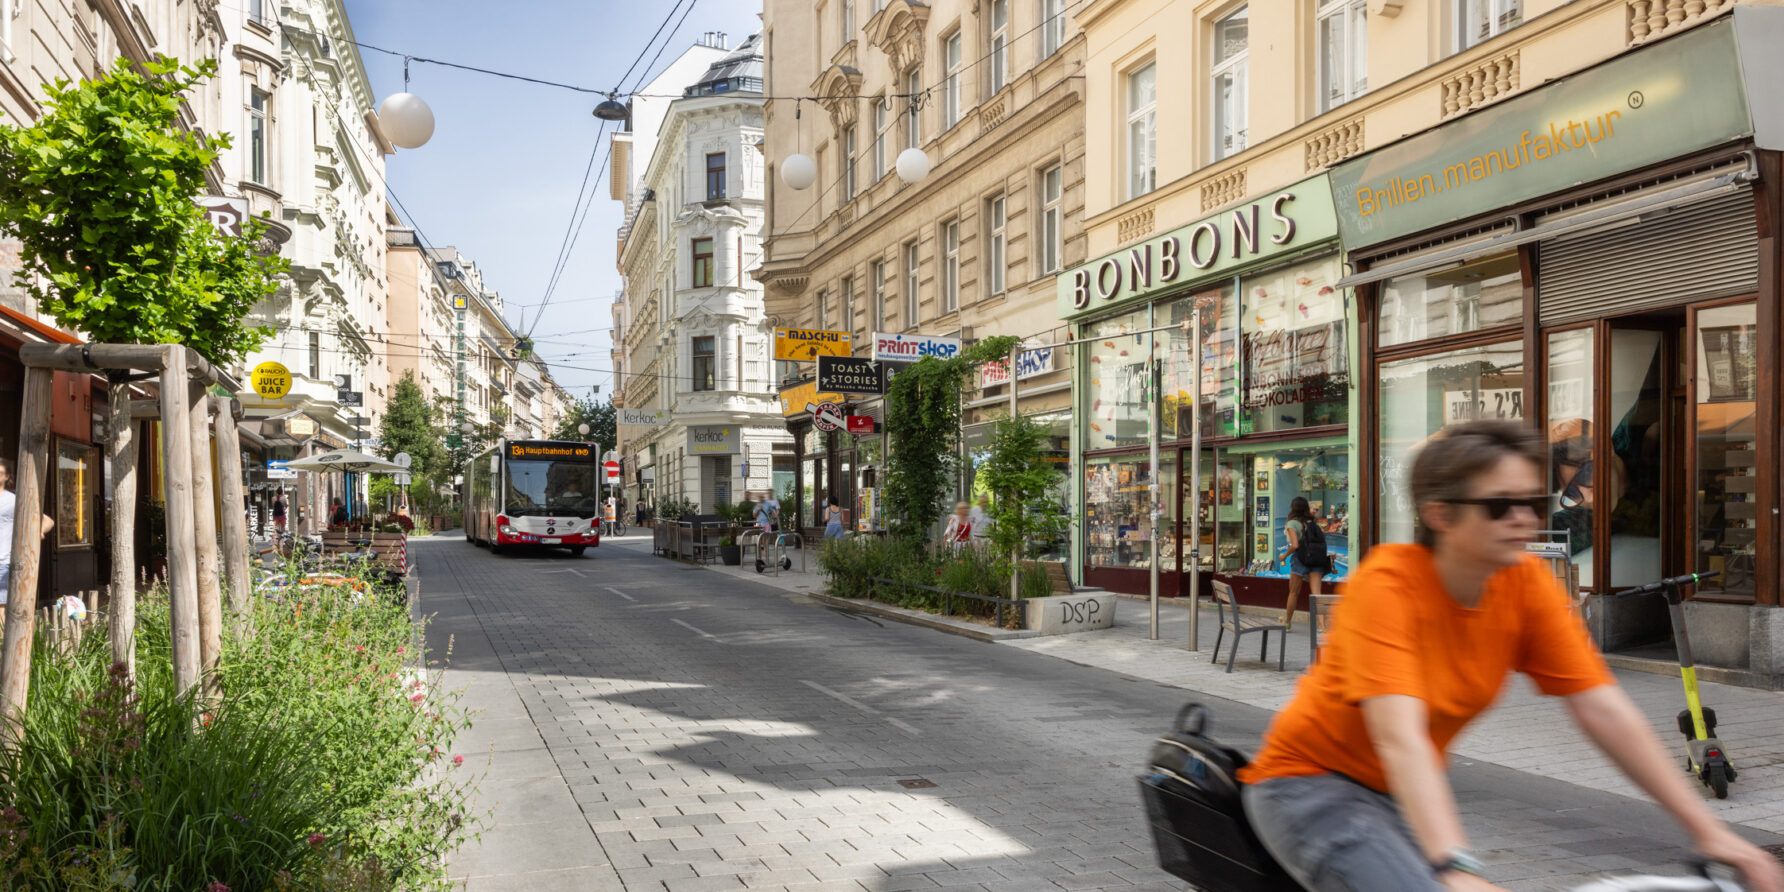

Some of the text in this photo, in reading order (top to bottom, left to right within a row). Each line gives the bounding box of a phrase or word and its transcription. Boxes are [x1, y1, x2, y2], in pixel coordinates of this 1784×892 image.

[1356, 109, 1622, 217] Brillen.manufaktur
[1073, 192, 1297, 310] BONBONS
[878, 335, 957, 357] PRINTSHOP
[830, 364, 867, 374] TOAST
[258, 378, 285, 386] JUICE
[831, 375, 878, 385] STORIES
[261, 386, 282, 394] BAR
[820, 404, 840, 416] TABAK
[624, 411, 656, 424] kerkoc
[695, 428, 724, 442] kerkoc
[512, 446, 524, 456] 13A
[525, 447, 573, 456] Hauptbahnhof
